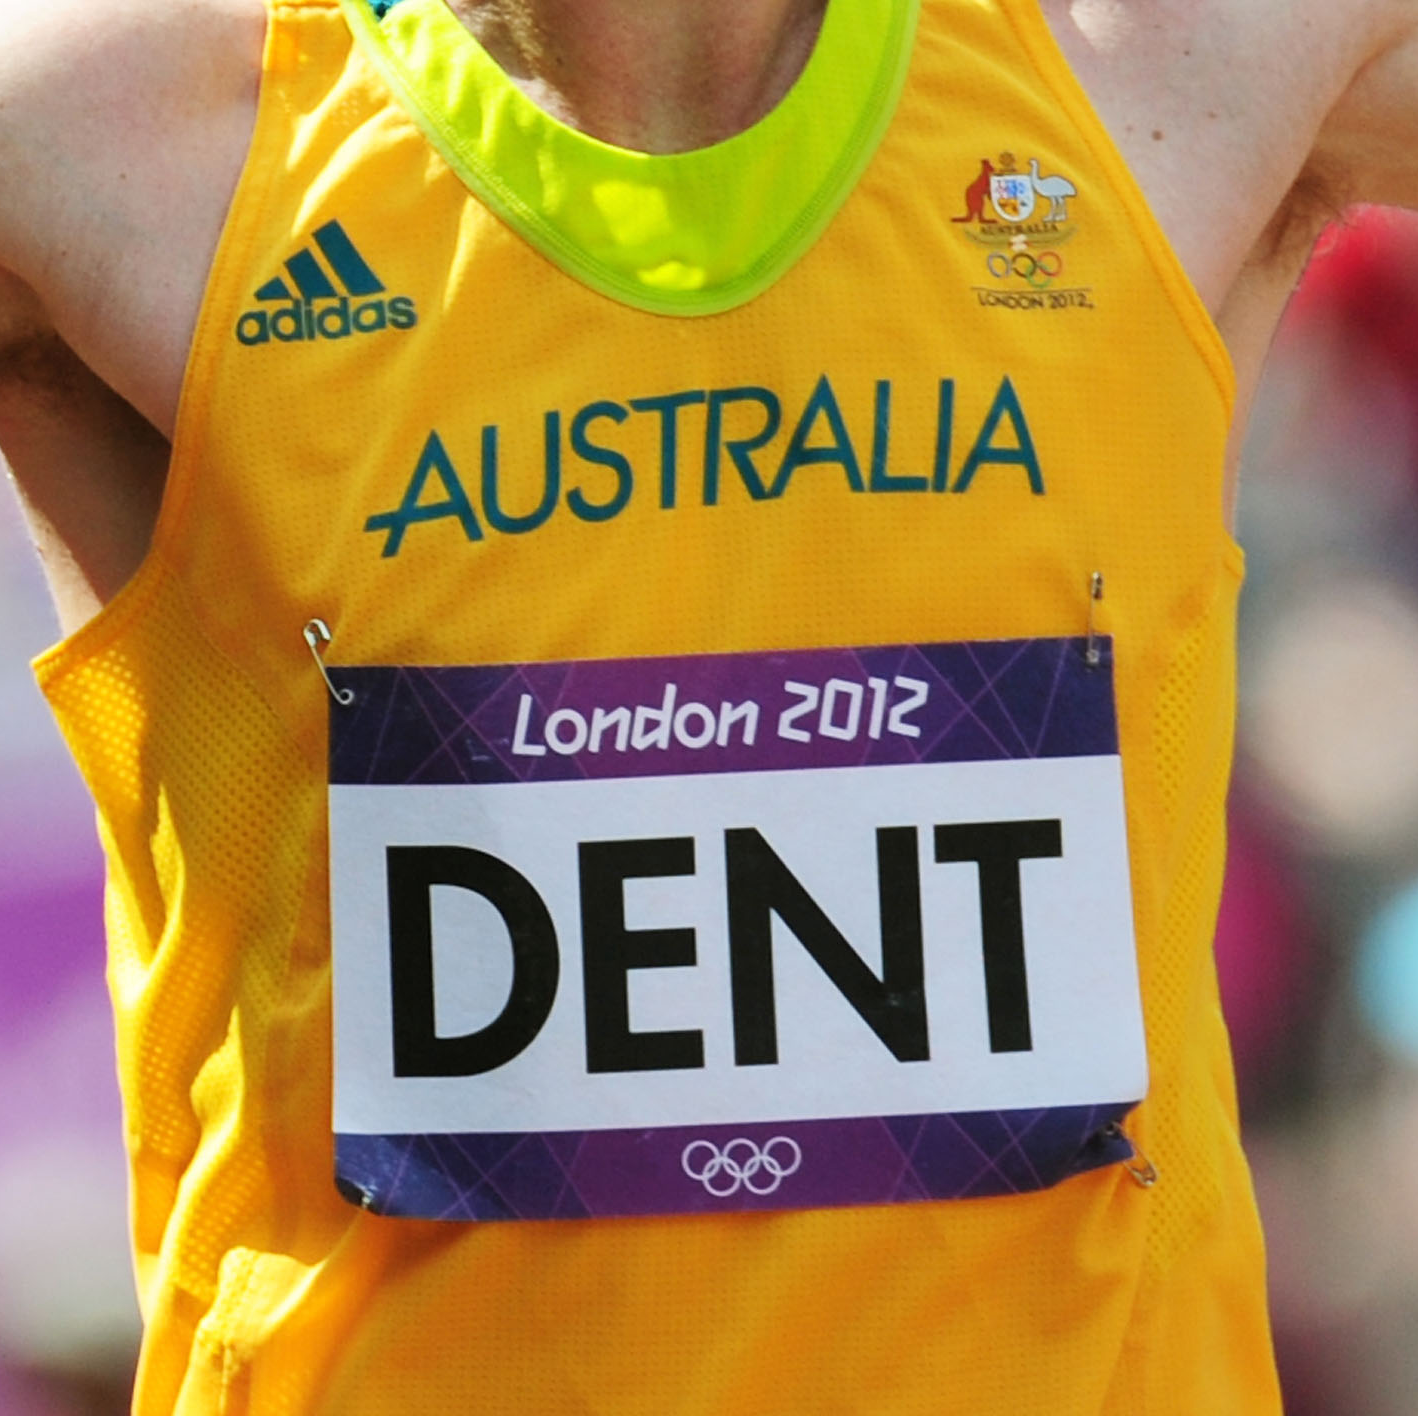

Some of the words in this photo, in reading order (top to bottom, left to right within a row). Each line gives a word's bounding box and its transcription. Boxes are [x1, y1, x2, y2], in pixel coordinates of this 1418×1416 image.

[236, 295, 417, 346] adidas
[978, 292, 1044, 310] LONDON
[364, 374, 1046, 558] AUSTRALIA
[511, 683, 760, 757] London
[777, 675, 929, 744] 2012
[385, 818, 1063, 1078] DENT
